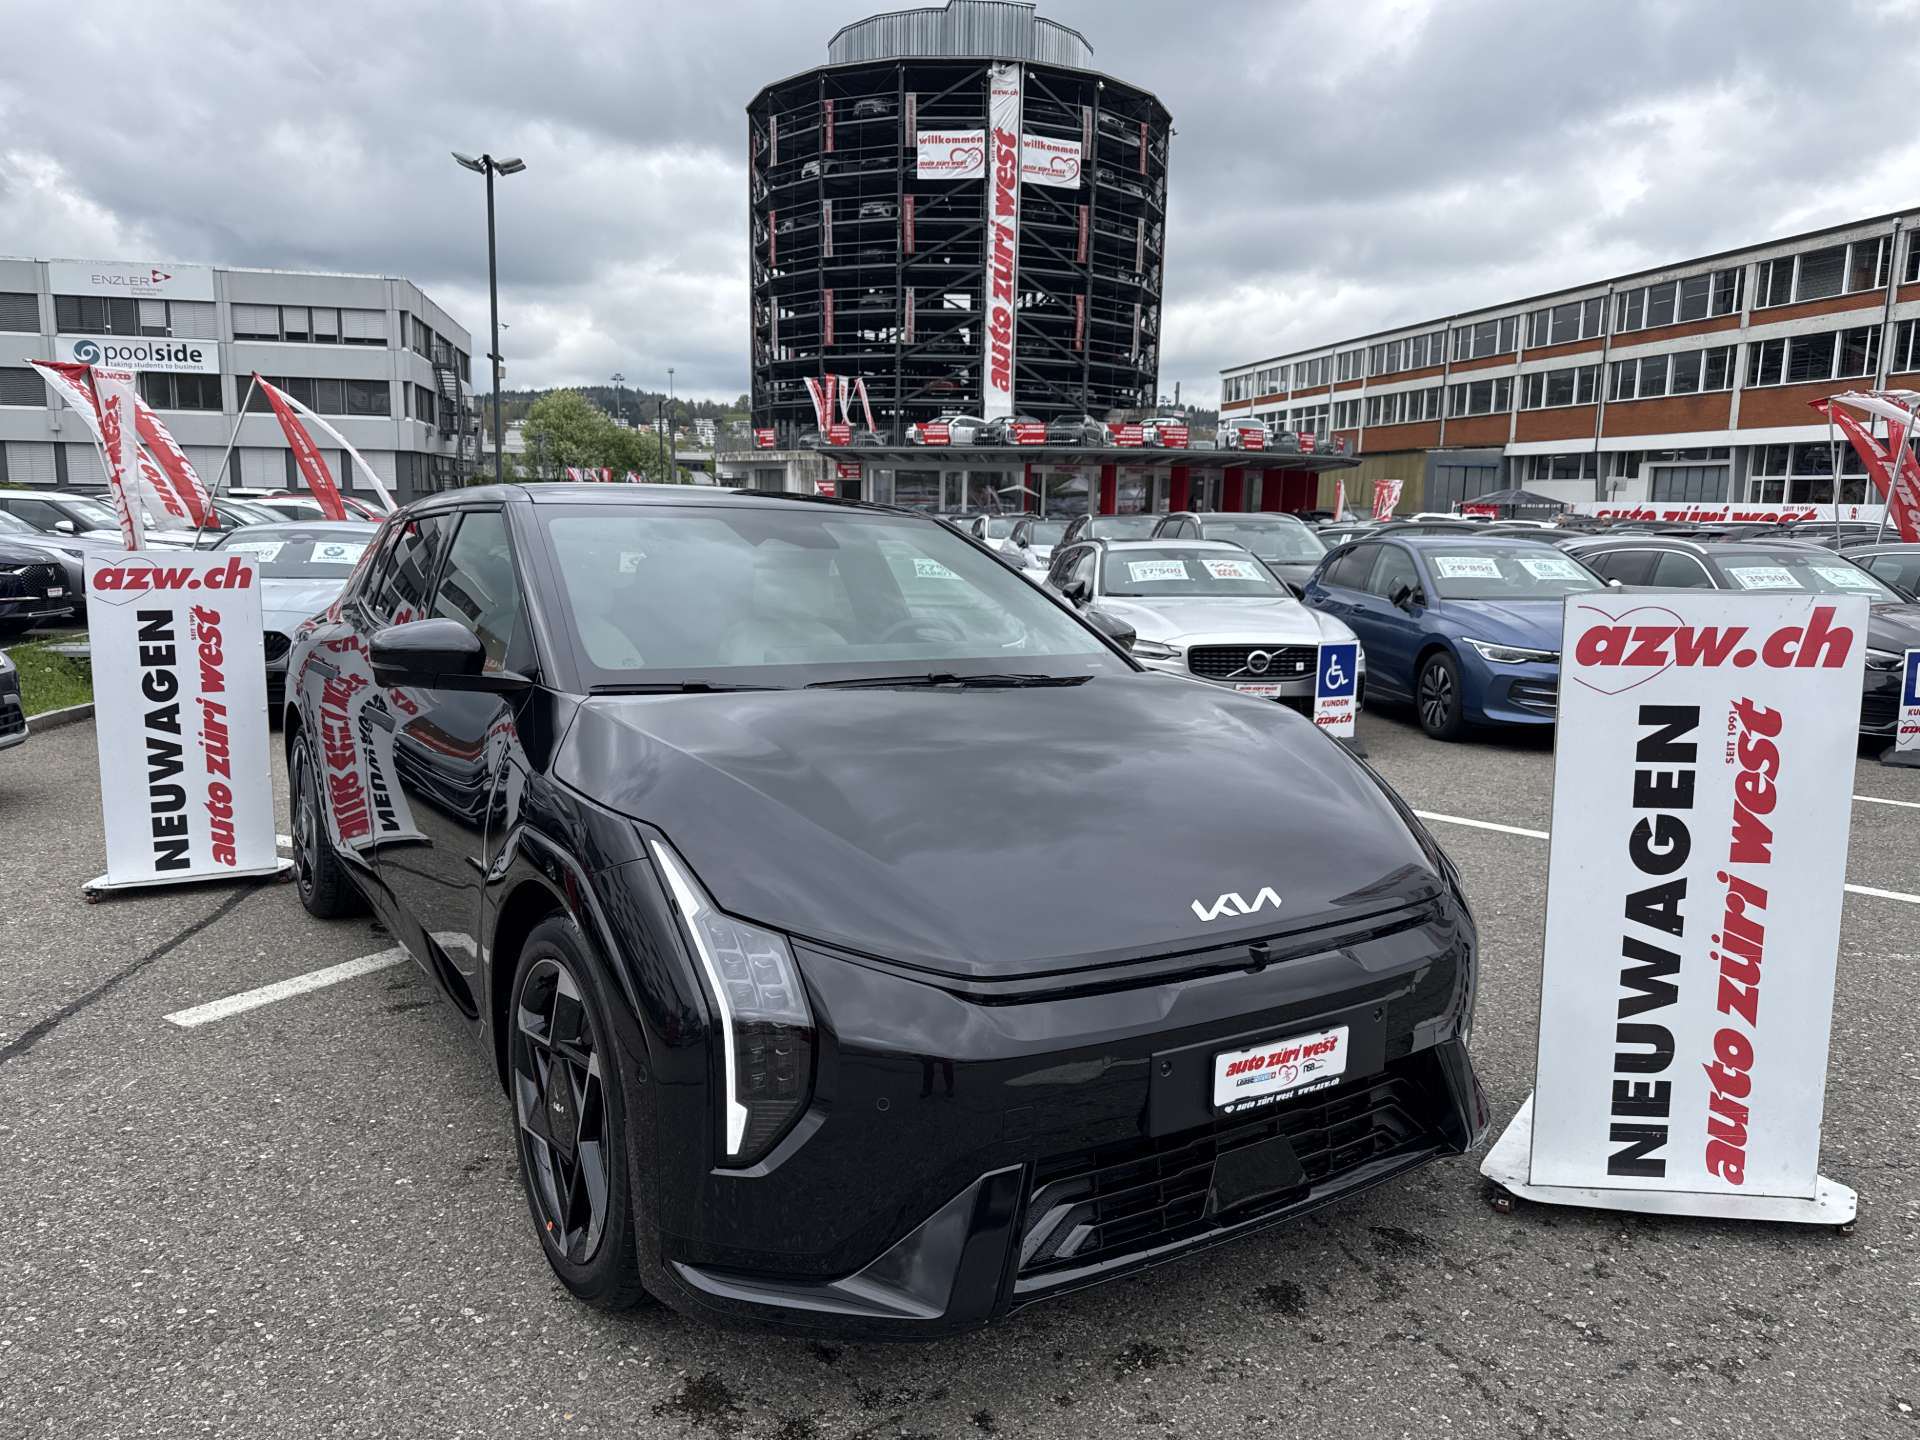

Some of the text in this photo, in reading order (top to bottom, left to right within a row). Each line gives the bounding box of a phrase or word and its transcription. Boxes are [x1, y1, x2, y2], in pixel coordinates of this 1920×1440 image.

[919, 135, 983, 145] willkommen
[1023, 139, 1080, 155] willkommen
[988, 127, 1017, 393] auto züri west
[91, 274, 149, 287] ENZLER
[104, 342, 203, 367] poolside
[110, 361, 133, 371] taking
[135, 362, 165, 370] students
[175, 362, 204, 371] business
[93, 557, 252, 590] azw.ch
[1575, 606, 1855, 669] azw.ch
[1316, 712, 1352, 725] azw.ch
[1321, 699, 1349, 708] KUNDEN
[136, 609, 191, 872] NEUWAGEN
[189, 604, 236, 867] auto züri west
[1725, 710, 1738, 764] SEIT 1991
[1606, 704, 1701, 1178] NEUWAGEN
[1701, 697, 1784, 1186] auto züri west
[1226, 1037, 1338, 1077] auto züri west
[1236, 1100, 1255, 1111] auto
[1257, 1095, 1275, 1106] züri
[1275, 1090, 1295, 1101] west
